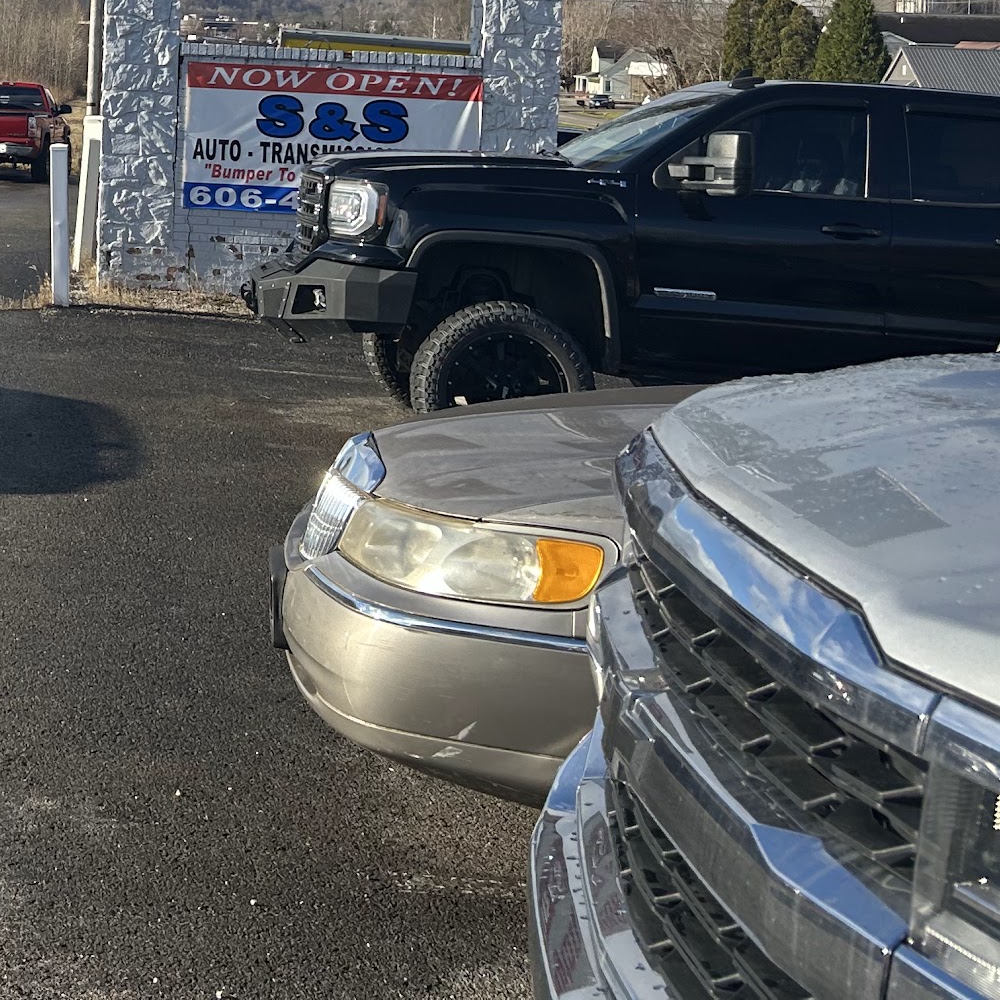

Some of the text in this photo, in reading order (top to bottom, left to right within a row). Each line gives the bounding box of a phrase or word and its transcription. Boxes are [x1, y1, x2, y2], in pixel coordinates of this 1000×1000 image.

[207, 66, 462, 97] NOW OPEN!
[256, 94, 409, 144] S&S
[192, 138, 242, 162] AUTO
[204, 163, 296, 184] "Bumper To
[189, 185, 299, 210] 606-4
